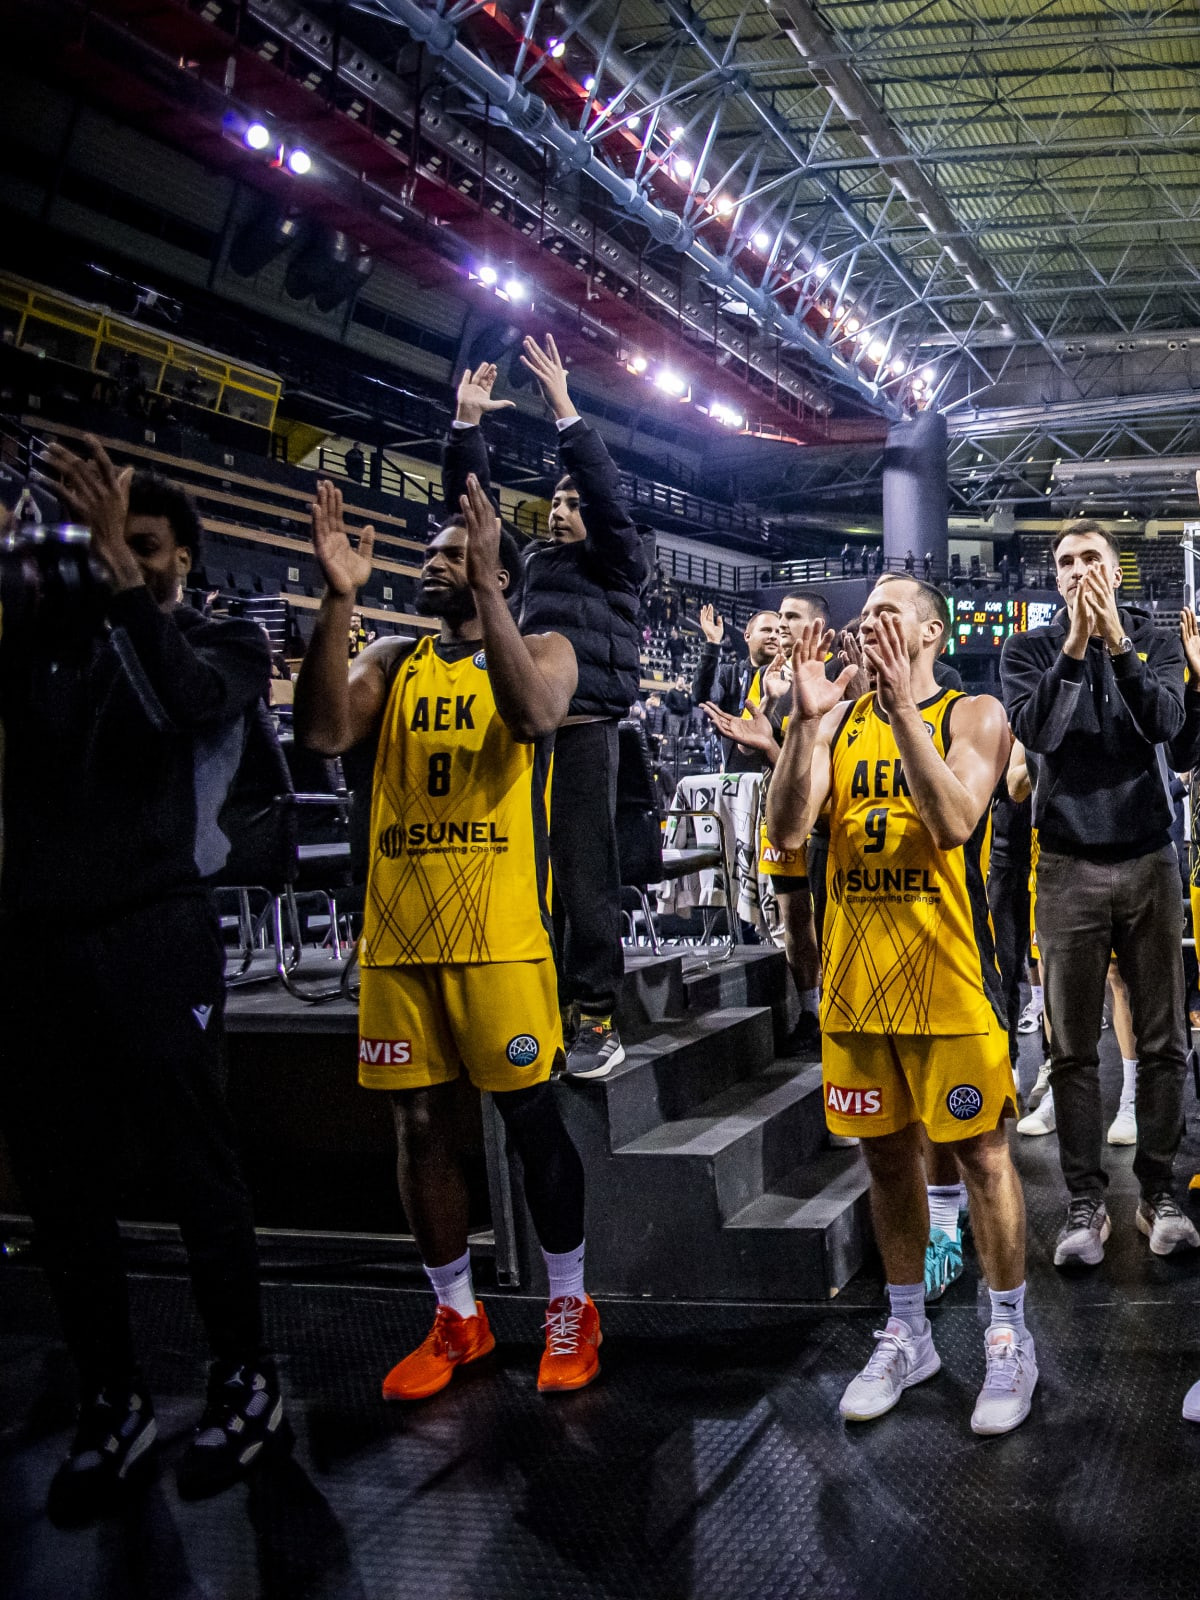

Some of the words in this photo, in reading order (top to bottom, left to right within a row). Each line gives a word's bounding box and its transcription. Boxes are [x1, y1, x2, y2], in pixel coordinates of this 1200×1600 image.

[957, 601, 975, 611] AEK
[985, 602, 1002, 612] KAR
[410, 694, 477, 732] AEK
[427, 752, 452, 797] 8
[408, 821, 508, 846] SUNEL
[863, 807, 890, 854] 9
[470, 845, 508, 854] Change
[763, 847, 795, 862] AVIS
[847, 868, 940, 893] SUNEL
[847, 895, 902, 905] Empowering
[904, 894, 940, 904] Change
[360, 1039, 410, 1063] AVIS
[828, 1086, 881, 1113] AVIS
